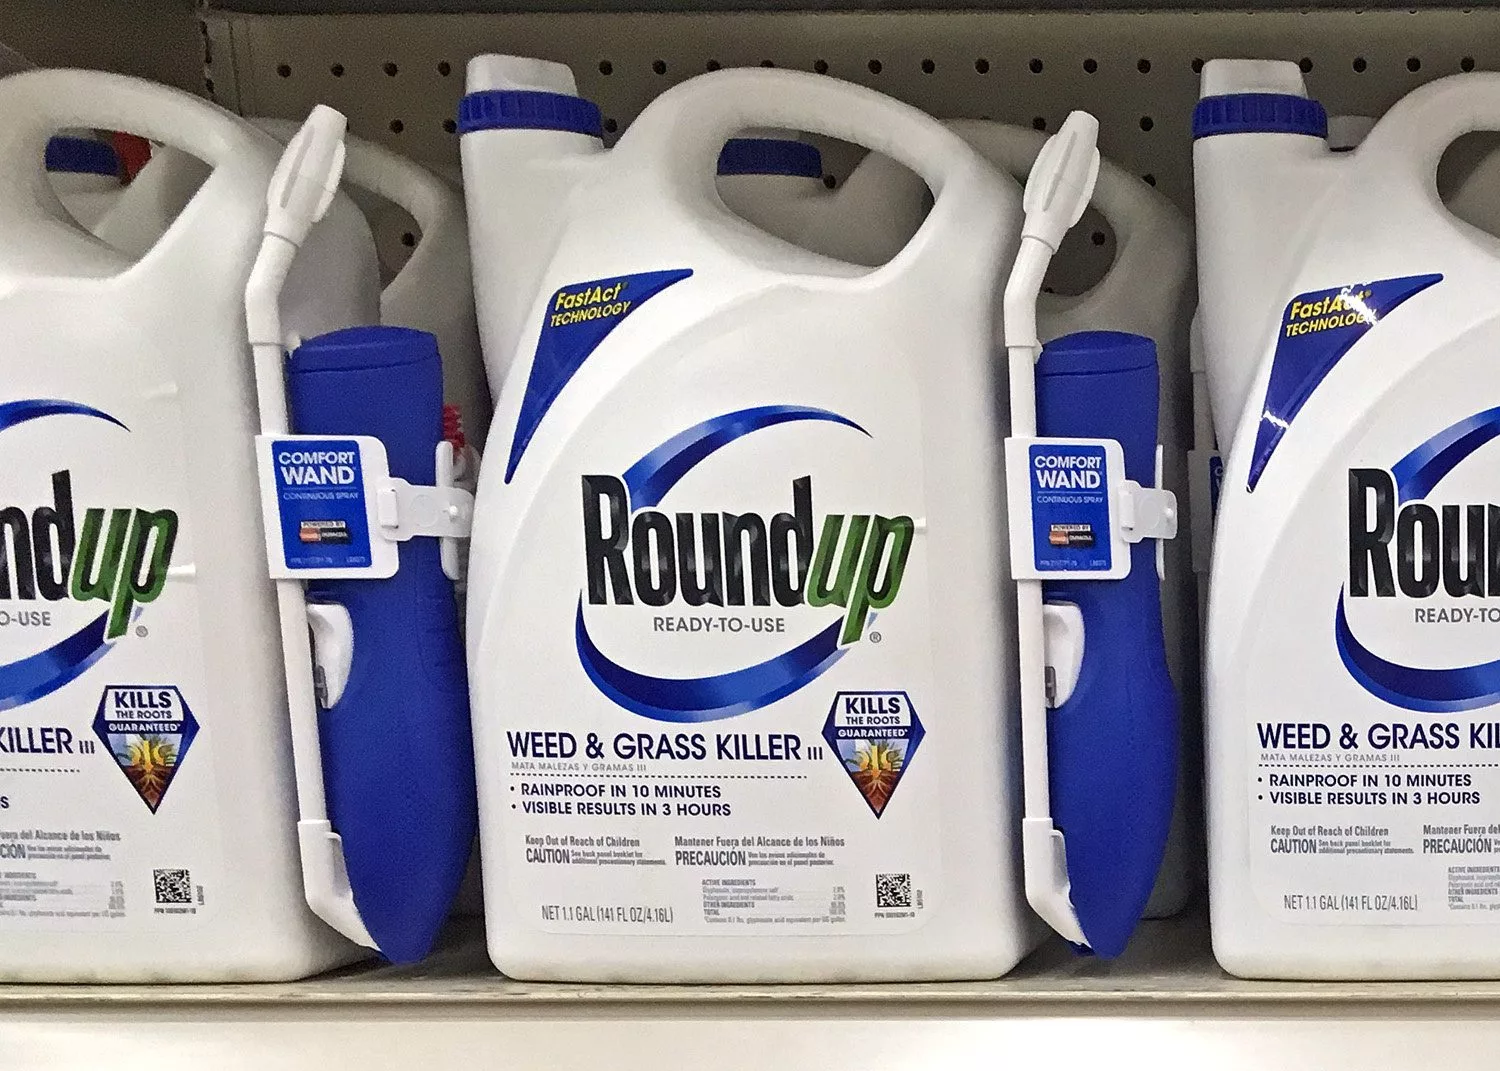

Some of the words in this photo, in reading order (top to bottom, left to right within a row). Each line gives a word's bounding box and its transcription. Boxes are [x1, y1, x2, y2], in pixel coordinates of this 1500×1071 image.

[555, 284, 621, 311] FastAct
[552, 301, 631, 328] TECHNOLOGY
[279, 452, 355, 467] COMFORT
[1034, 456, 1102, 469] COMFORT
[281, 467, 354, 484] WAND
[1035, 470, 1100, 489] WAND
[582, 474, 916, 650] Roundup
[654, 617, 784, 632] READY-TO-USE
[115, 691, 171, 708] KILLS
[846, 697, 900, 714] KILLS
[113, 711, 136, 721] THE
[137, 711, 172, 721] ROOTS
[845, 715, 866, 725] THE
[868, 715, 901, 725] ROOTS
[838, 729, 906, 740] GUARANTEED
[1257, 723, 1330, 749] WEED
[1339, 723, 1358, 749] &
[1368, 723, 1459, 749] GRASS
[507, 732, 576, 758] WEED
[586, 733, 604, 759] &
[614, 733, 706, 760] GRASS
[716, 734, 801, 760] KILLER
[521, 783, 605, 797] RAINPROOF
[611, 785, 626, 797] IN
[632, 785, 649, 797] 10
[655, 785, 721, 798] MINUTES
[523, 801, 572, 814] VISIBLE
[577, 802, 636, 815] RESULTS
[641, 803, 656, 815] IN
[663, 803, 671, 815] 3
[677, 804, 731, 816] HOURS
[525, 835, 544, 847] Keep
[545, 836, 559, 846] Out
[560, 836, 568, 846] of
[570, 836, 594, 846] Reach
[596, 836, 604, 847] of
[606, 836, 640, 847] Children
[526, 849, 570, 865] CAUTION
[675, 847, 746, 867] PRECAUCIÓN
[541, 906, 560, 921] NET
[561, 906, 573, 921] 1.1
[575, 906, 595, 922] GAL
[596, 906, 614, 923] (141
[616, 906, 628, 922] FL
[630, 906, 674, 924] OZ/4.16L)
